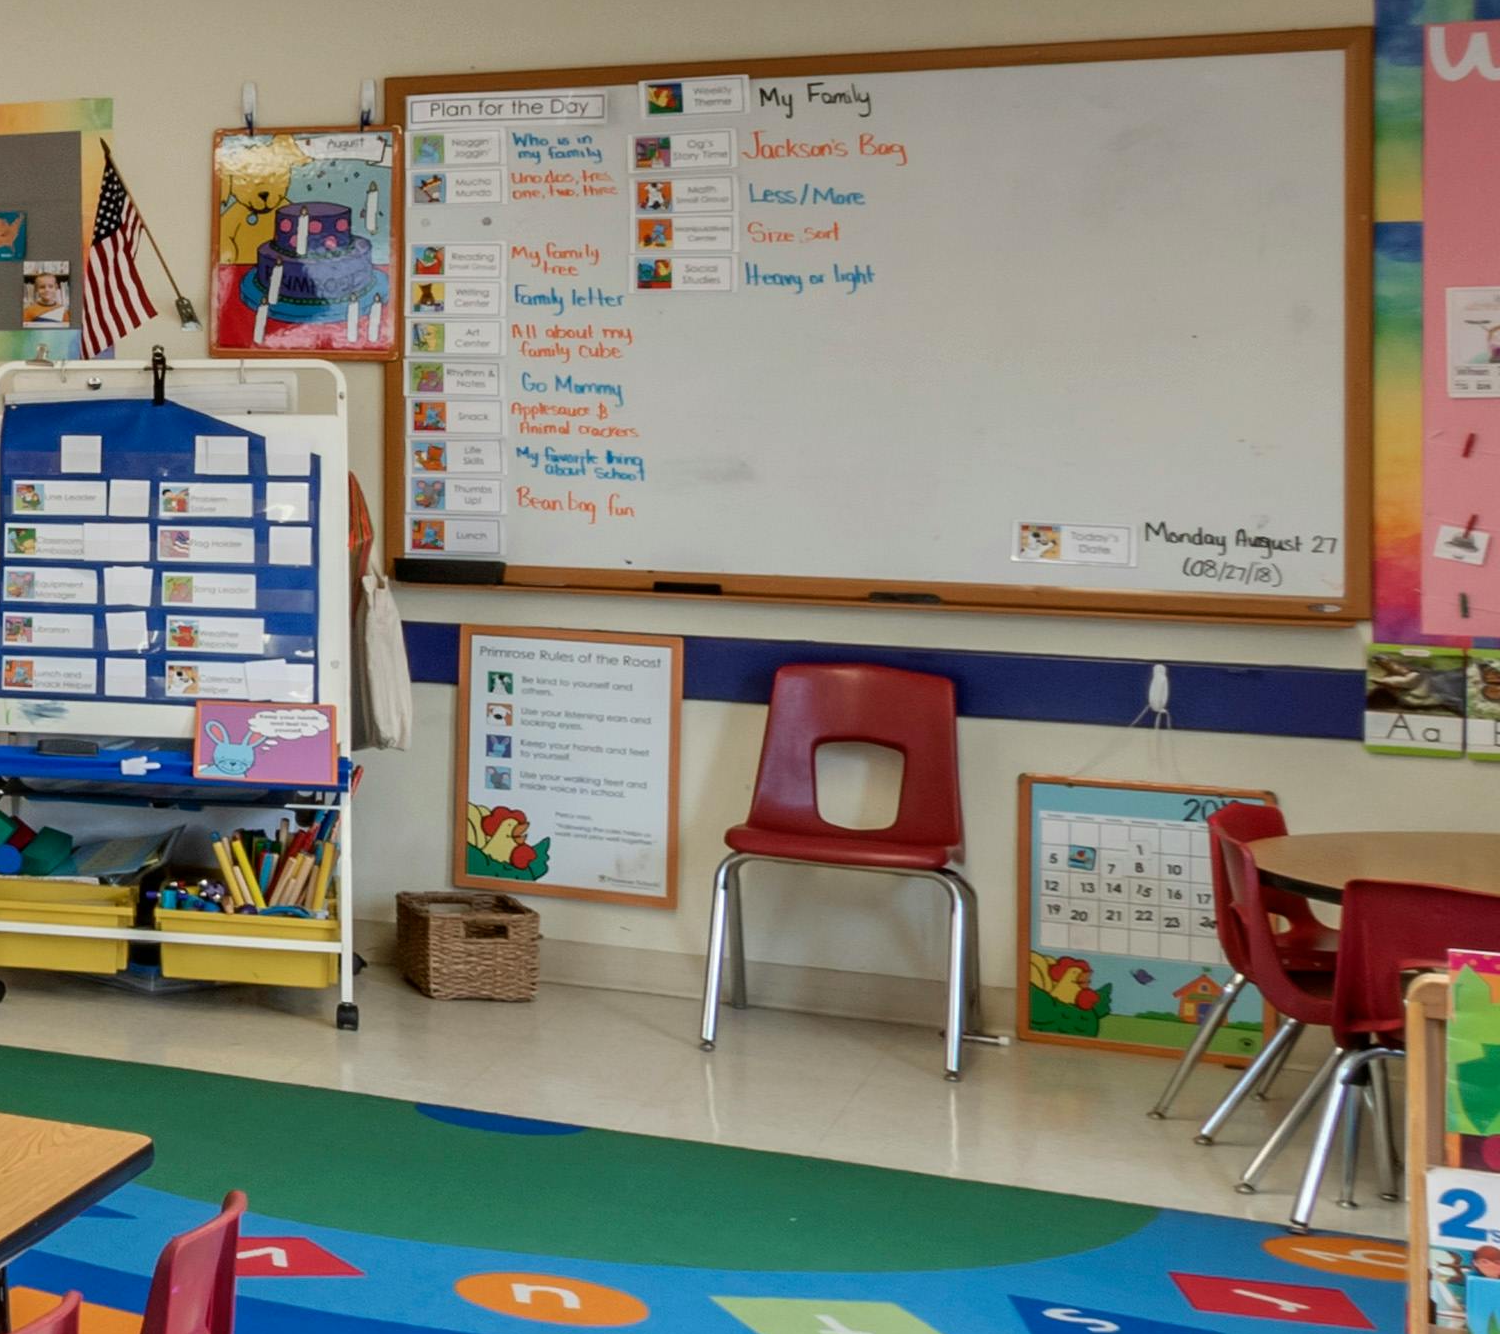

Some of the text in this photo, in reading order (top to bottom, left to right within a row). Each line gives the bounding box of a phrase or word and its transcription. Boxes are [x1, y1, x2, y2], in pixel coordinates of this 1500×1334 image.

[430, 98, 589, 117] Plan for the Day
[759, 82, 872, 118] My Family
[326, 137, 365, 151] August
[512, 131, 549, 147] Who
[742, 130, 908, 167] Jackson's Bag
[518, 146, 602, 164] my family
[749, 182, 866, 206] Less/More
[511, 242, 601, 267] My family
[543, 264, 579, 277] tree
[744, 262, 803, 294] Heavy
[833, 264, 875, 295] light
[514, 284, 625, 316] Family letter
[511, 323, 633, 344] All about my
[519, 342, 623, 363] family cube
[521, 371, 548, 393] Go
[457, 412, 489, 422] Snack
[519, 421, 571, 437] Animal
[515, 446, 540, 468] My
[516, 486, 565, 512] Bean
[607, 493, 636, 518] fun
[456, 531, 488, 541] Lunch
[1145, 521, 1337, 559] Monday August 27
[479, 645, 662, 669] Primrose Rules of the Roost
[1136, 844, 1143, 856] 1
[1049, 853, 1183, 876] 5 7 8 10
[1044, 880, 1212, 905] 12 13 14 15 16 17
[1046, 904, 1061, 916] 19
[1070, 910, 1088, 922] 20
[1106, 910, 1123, 922] 21
[1135, 910, 1154, 922] 22
[1164, 917, 1181, 929] 23
